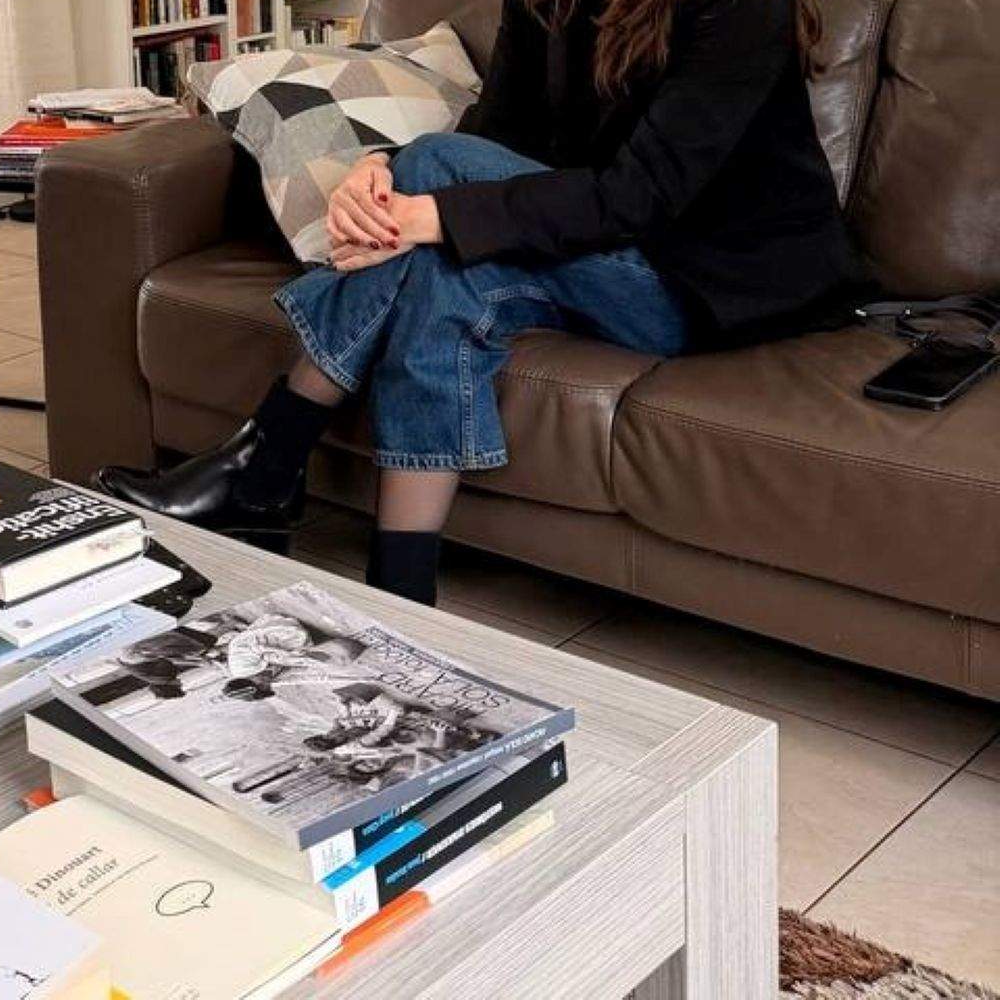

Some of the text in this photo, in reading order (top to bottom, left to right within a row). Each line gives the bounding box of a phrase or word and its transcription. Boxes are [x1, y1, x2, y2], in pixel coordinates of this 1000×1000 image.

[36, 845, 104, 891] Dinouart
[56, 887, 78, 905] de
[77, 857, 120, 890] callar
